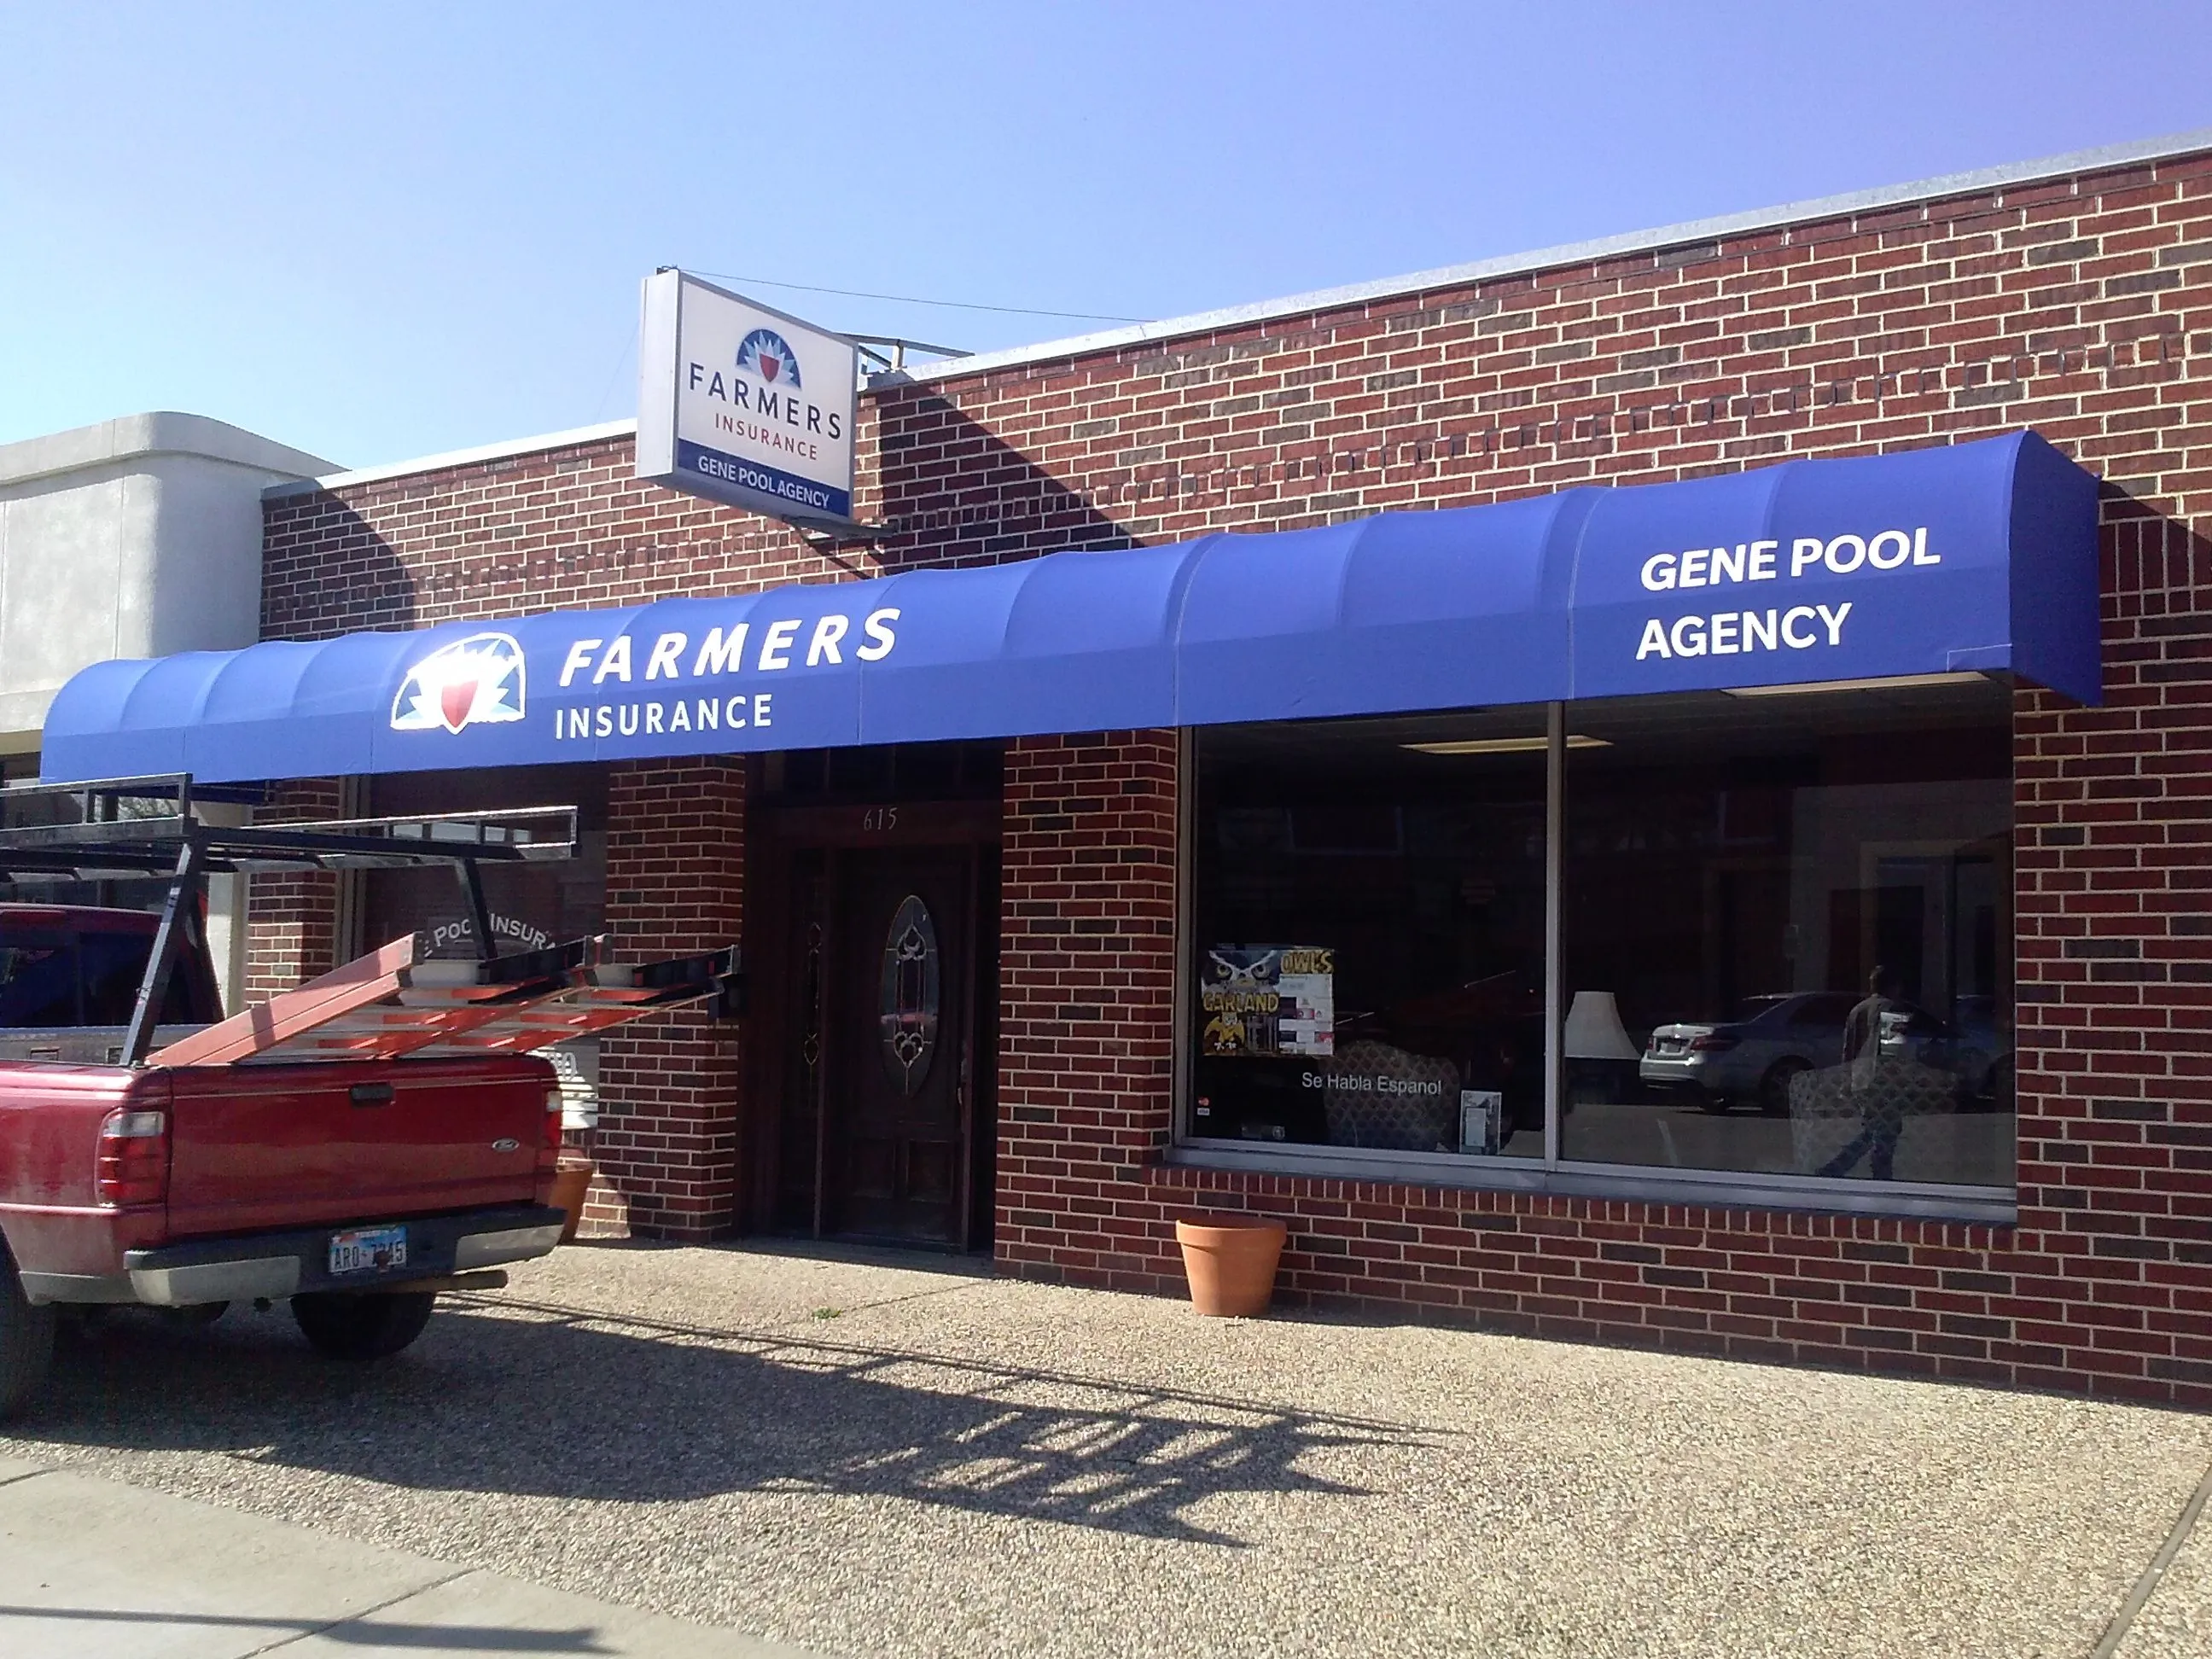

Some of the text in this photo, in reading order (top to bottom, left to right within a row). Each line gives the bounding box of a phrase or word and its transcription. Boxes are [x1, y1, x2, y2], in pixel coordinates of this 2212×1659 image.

[690, 362, 841, 440] FARMERS
[715, 413, 818, 461] INSURANCE
[698, 456, 830, 509] GENE POOL AGENCY
[1640, 527, 1941, 591] GENE POOL
[559, 608, 901, 687] FARMERS
[1635, 602, 1853, 661] AGENCY
[555, 694, 772, 740] INSURANCE
[864, 806, 898, 830] 615
[1280, 951, 1334, 974] OWLS
[1202, 992, 1280, 1014] GARLAND
[1301, 1072, 1442, 1097] Se Habla Espanol
